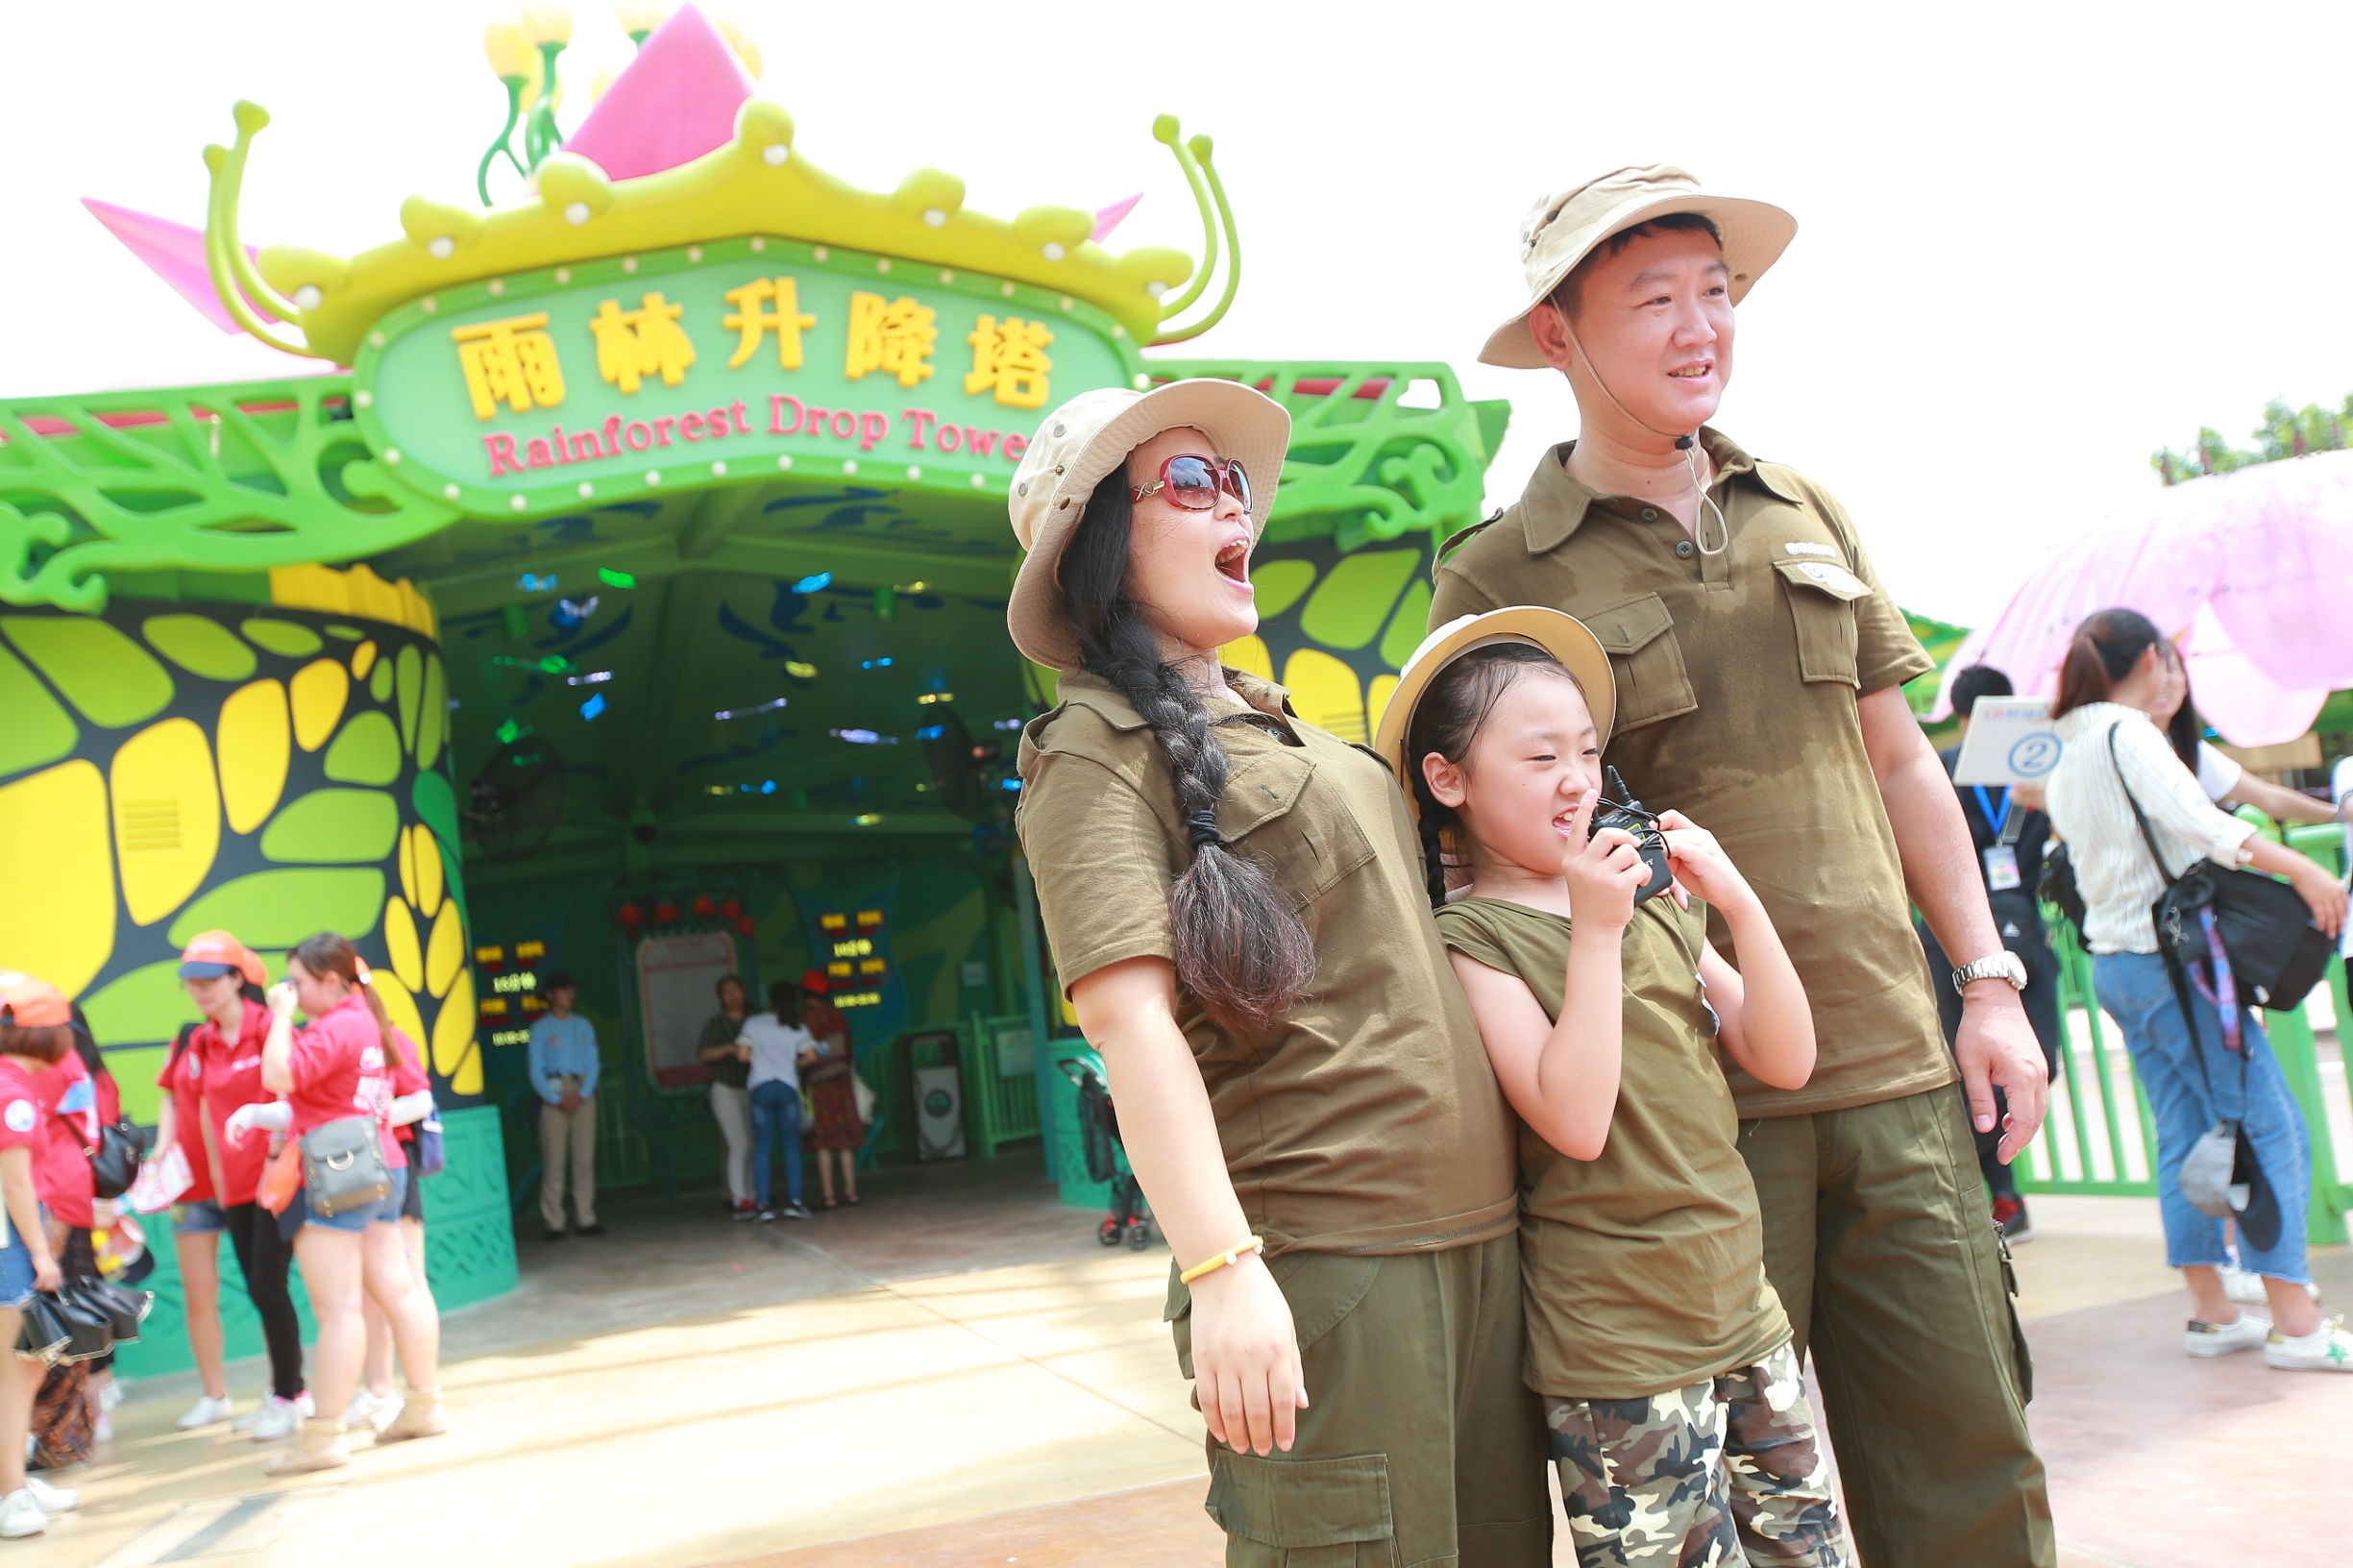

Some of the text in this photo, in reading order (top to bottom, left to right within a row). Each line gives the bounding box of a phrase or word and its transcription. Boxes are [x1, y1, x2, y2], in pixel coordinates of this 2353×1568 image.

[452, 276, 1054, 421] 雨林升降塔
[482, 395, 1032, 477] Rainforest Drop Towe
[2022, 742, 2047, 767] 2
